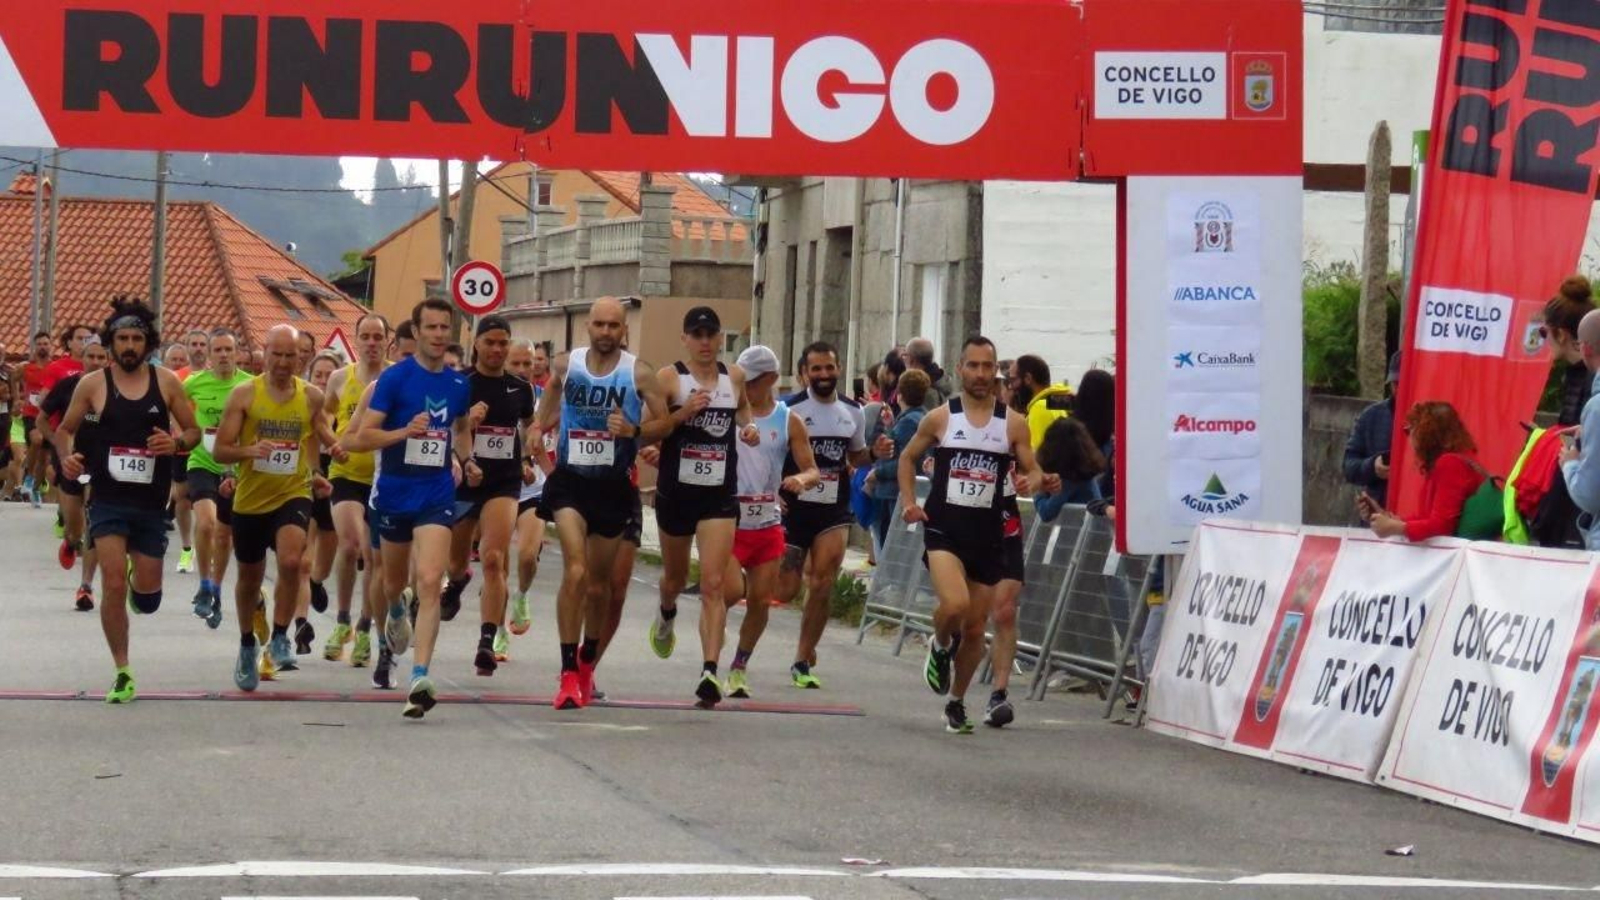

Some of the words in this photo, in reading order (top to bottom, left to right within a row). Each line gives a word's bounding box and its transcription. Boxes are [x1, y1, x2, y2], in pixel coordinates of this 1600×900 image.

[1105, 67, 1216, 83] CONCELLO
[1118, 88, 1144, 104] DE
[1152, 88, 1203, 104] VIGO
[1442, 0, 1525, 178] RU
[1510, 0, 1600, 194] RU
[464, 279, 494, 297] 30
[1425, 301, 1502, 322] CONCELLO
[1430, 322, 1450, 338] DE
[1197, 352, 1257, 365] CaixaBank
[570, 384, 627, 408] ADN
[1173, 414, 1257, 435] Alcampo
[420, 441, 439, 455] 82
[487, 437, 504, 449] 66
[579, 441, 604, 455] 100
[119, 458, 146, 472] 148
[694, 461, 712, 475] 85
[959, 481, 986, 497] 137
[747, 504, 763, 516] 52
[1180, 494, 1214, 514] AGUA
[1216, 493, 1249, 514] SANA
[1328, 590, 1426, 649] CONCELLO
[1176, 632, 1206, 679] DE
[1312, 657, 1347, 707] DE
[1438, 678, 1478, 735] DE
